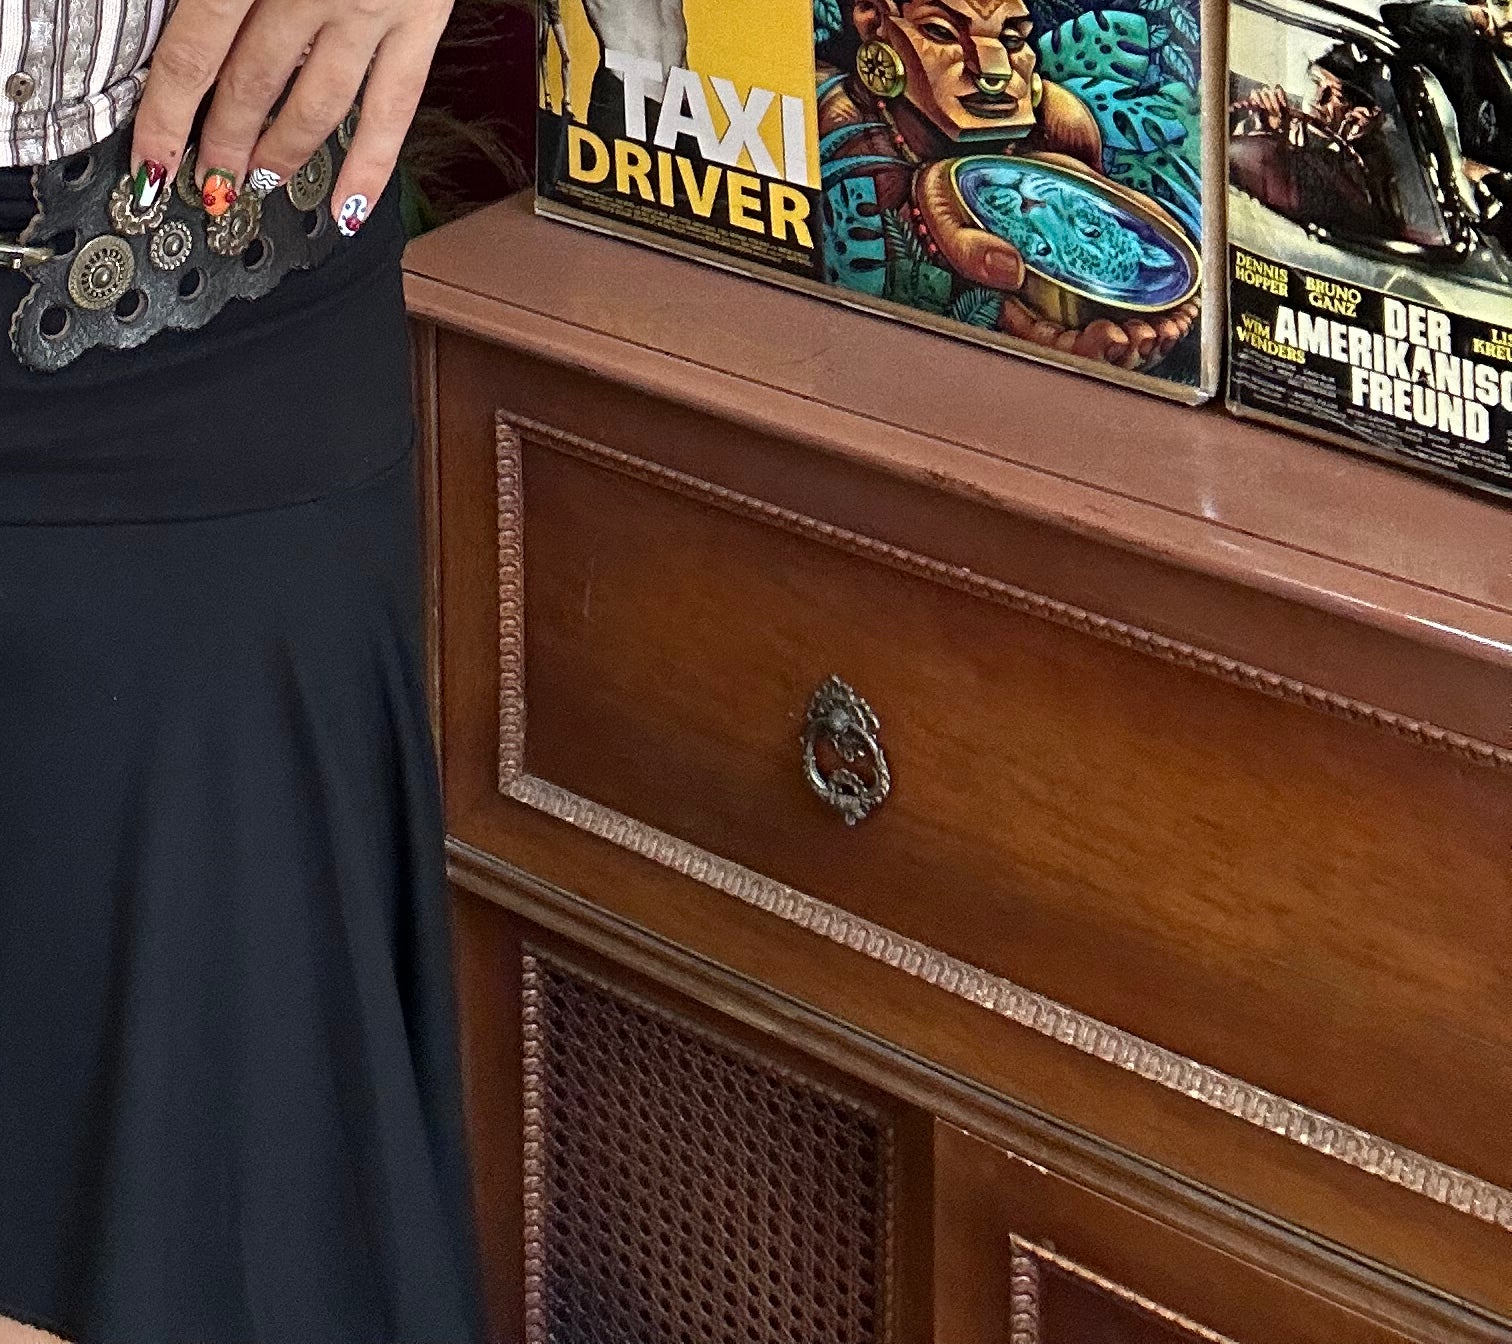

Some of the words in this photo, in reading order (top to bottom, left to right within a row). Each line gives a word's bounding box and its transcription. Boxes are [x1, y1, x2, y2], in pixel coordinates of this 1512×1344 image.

[604, 48, 822, 191] TAXI
[568, 124, 815, 250] DRIVER
[1235, 251, 1289, 284] DENNIS
[1235, 266, 1289, 298] HOPPER
[1305, 276, 1363, 305] BRUNO
[1308, 293, 1359, 319] GANZ
[1241, 313, 1271, 340] WIM
[1383, 296, 1452, 355] DER
[1236, 325, 1307, 365] WENDERS
[1351, 365, 1491, 445] FREUND
